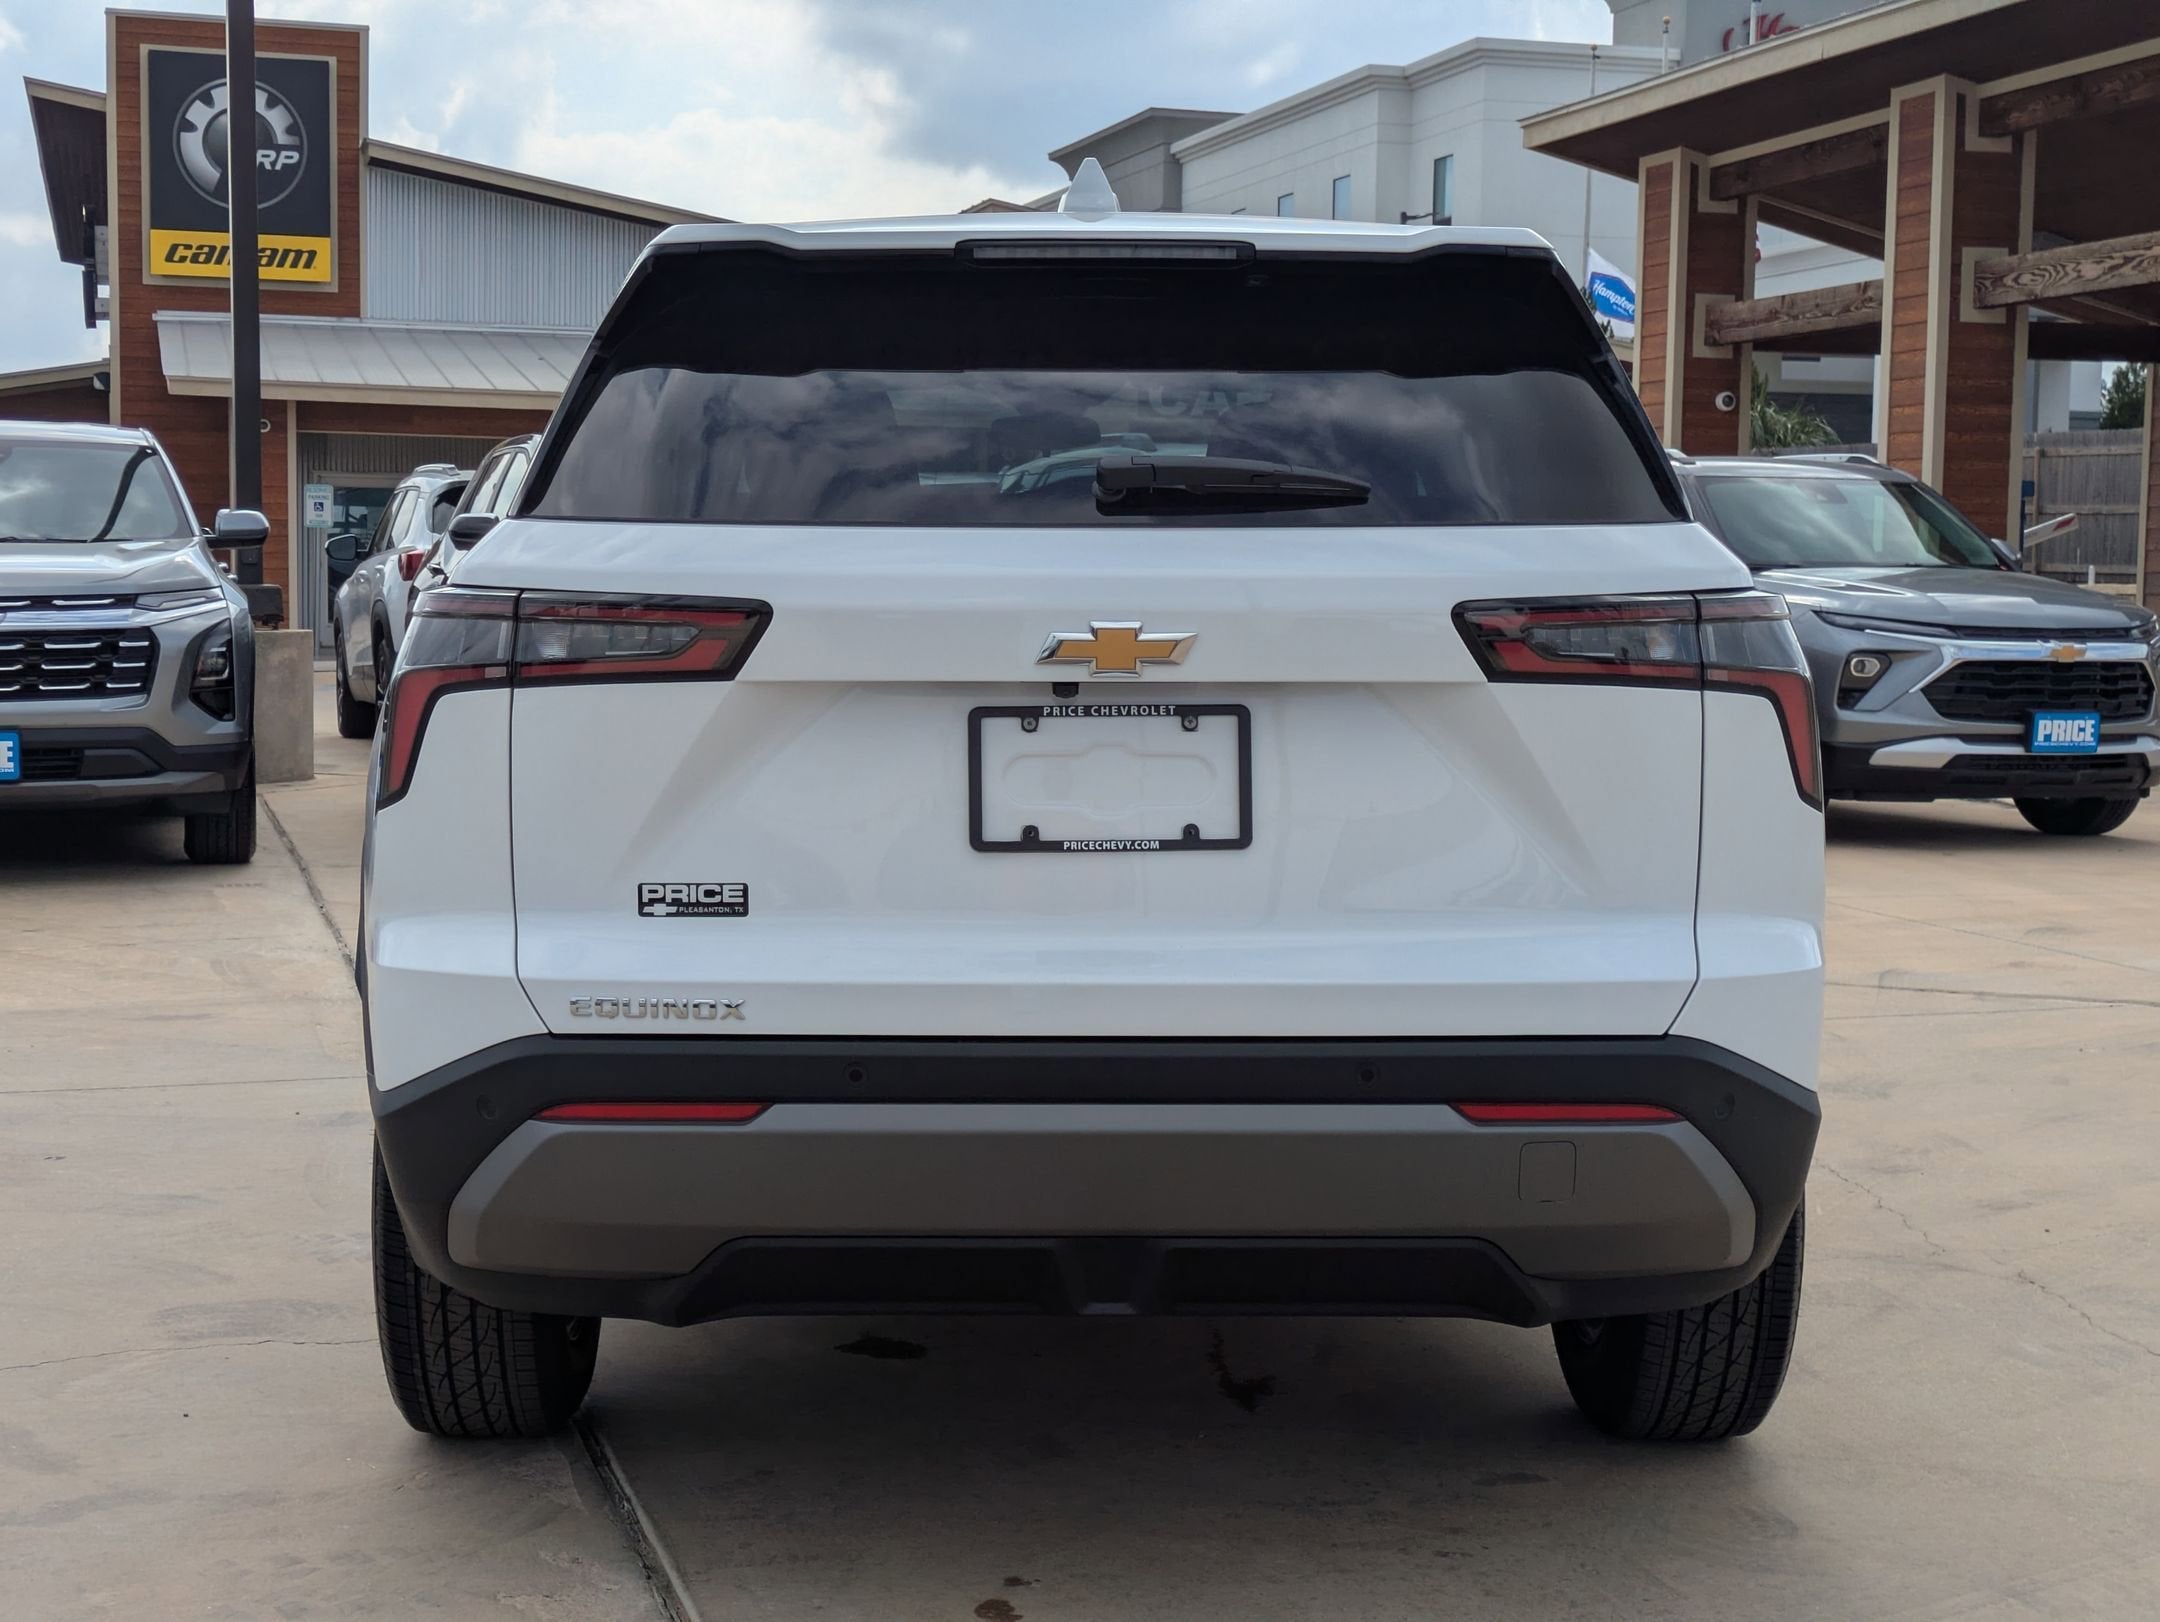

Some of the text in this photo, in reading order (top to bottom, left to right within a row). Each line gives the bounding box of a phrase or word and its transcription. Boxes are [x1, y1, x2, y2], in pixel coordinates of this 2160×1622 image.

[256, 149, 300, 171] RP
[1043, 705, 1176, 717] PRICE CHEVROLET
[2036, 719, 2096, 742] PRICE
[1063, 840, 1160, 851] PRICECHEVY.COM
[641, 884, 745, 903] PRICE
[679, 906, 733, 914] PLEASANTON,
[569, 996, 747, 1020] EQUINOX
